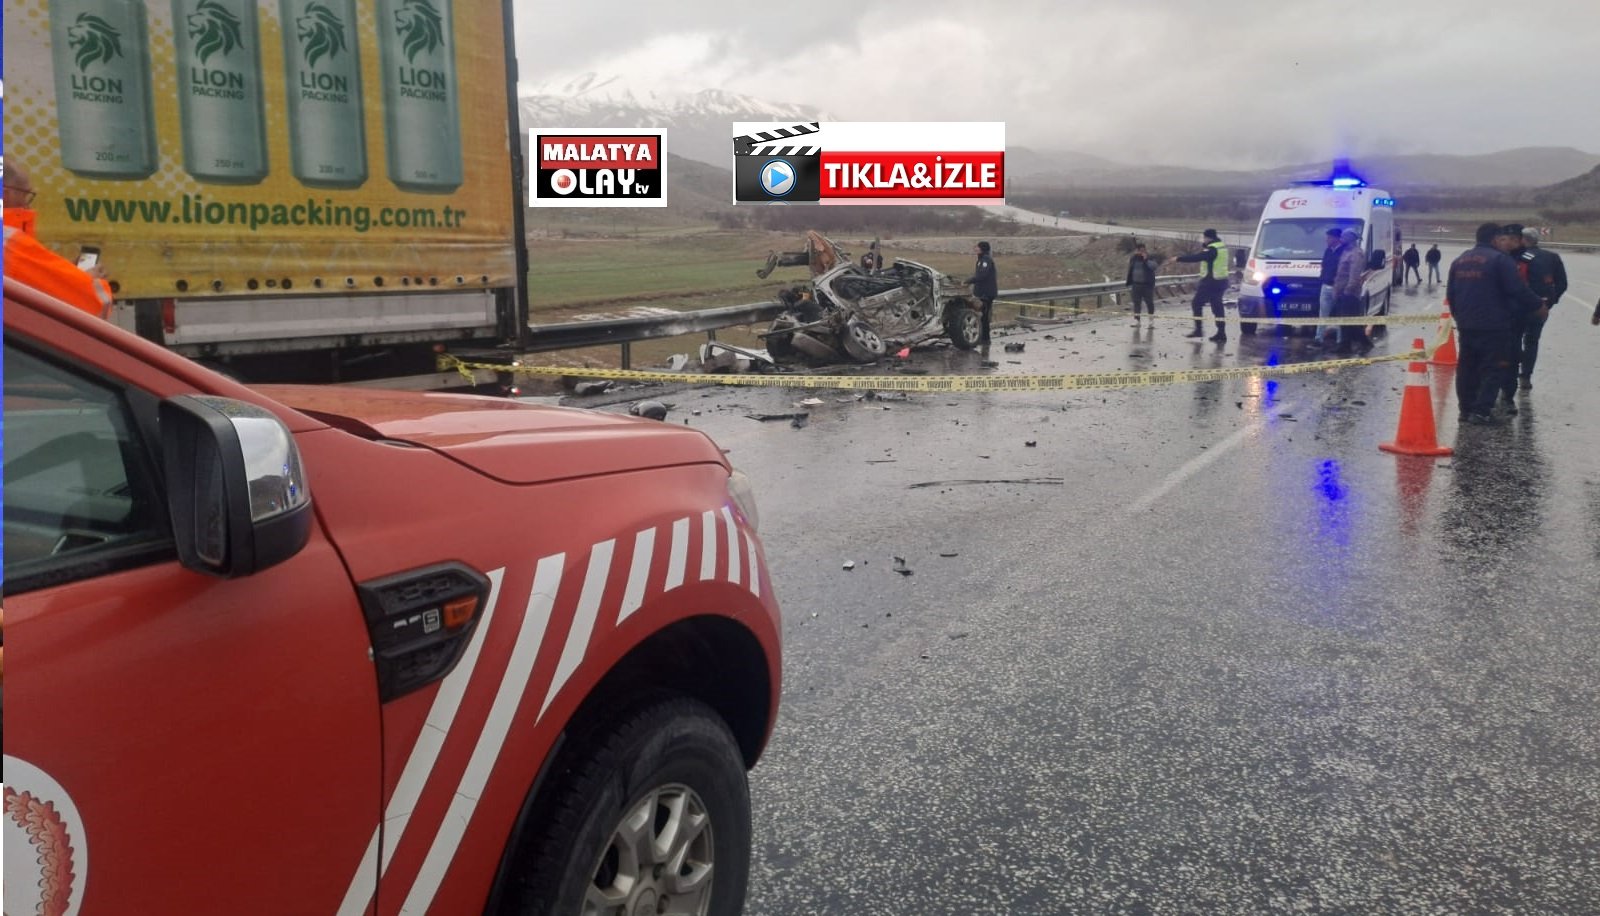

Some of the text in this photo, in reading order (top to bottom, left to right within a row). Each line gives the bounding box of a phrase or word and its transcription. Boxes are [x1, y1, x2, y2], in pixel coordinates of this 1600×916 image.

[71, 74, 123, 94] LION
[192, 67, 243, 89] LION
[301, 71, 347, 92] LION
[400, 66, 446, 90] LION
[73, 91, 123, 104] PACKING
[193, 86, 245, 101] PACKING
[302, 90, 348, 104] PACKING
[401, 87, 447, 102] PACKING
[64, 194, 467, 232] www.lionpacking.com.tr
